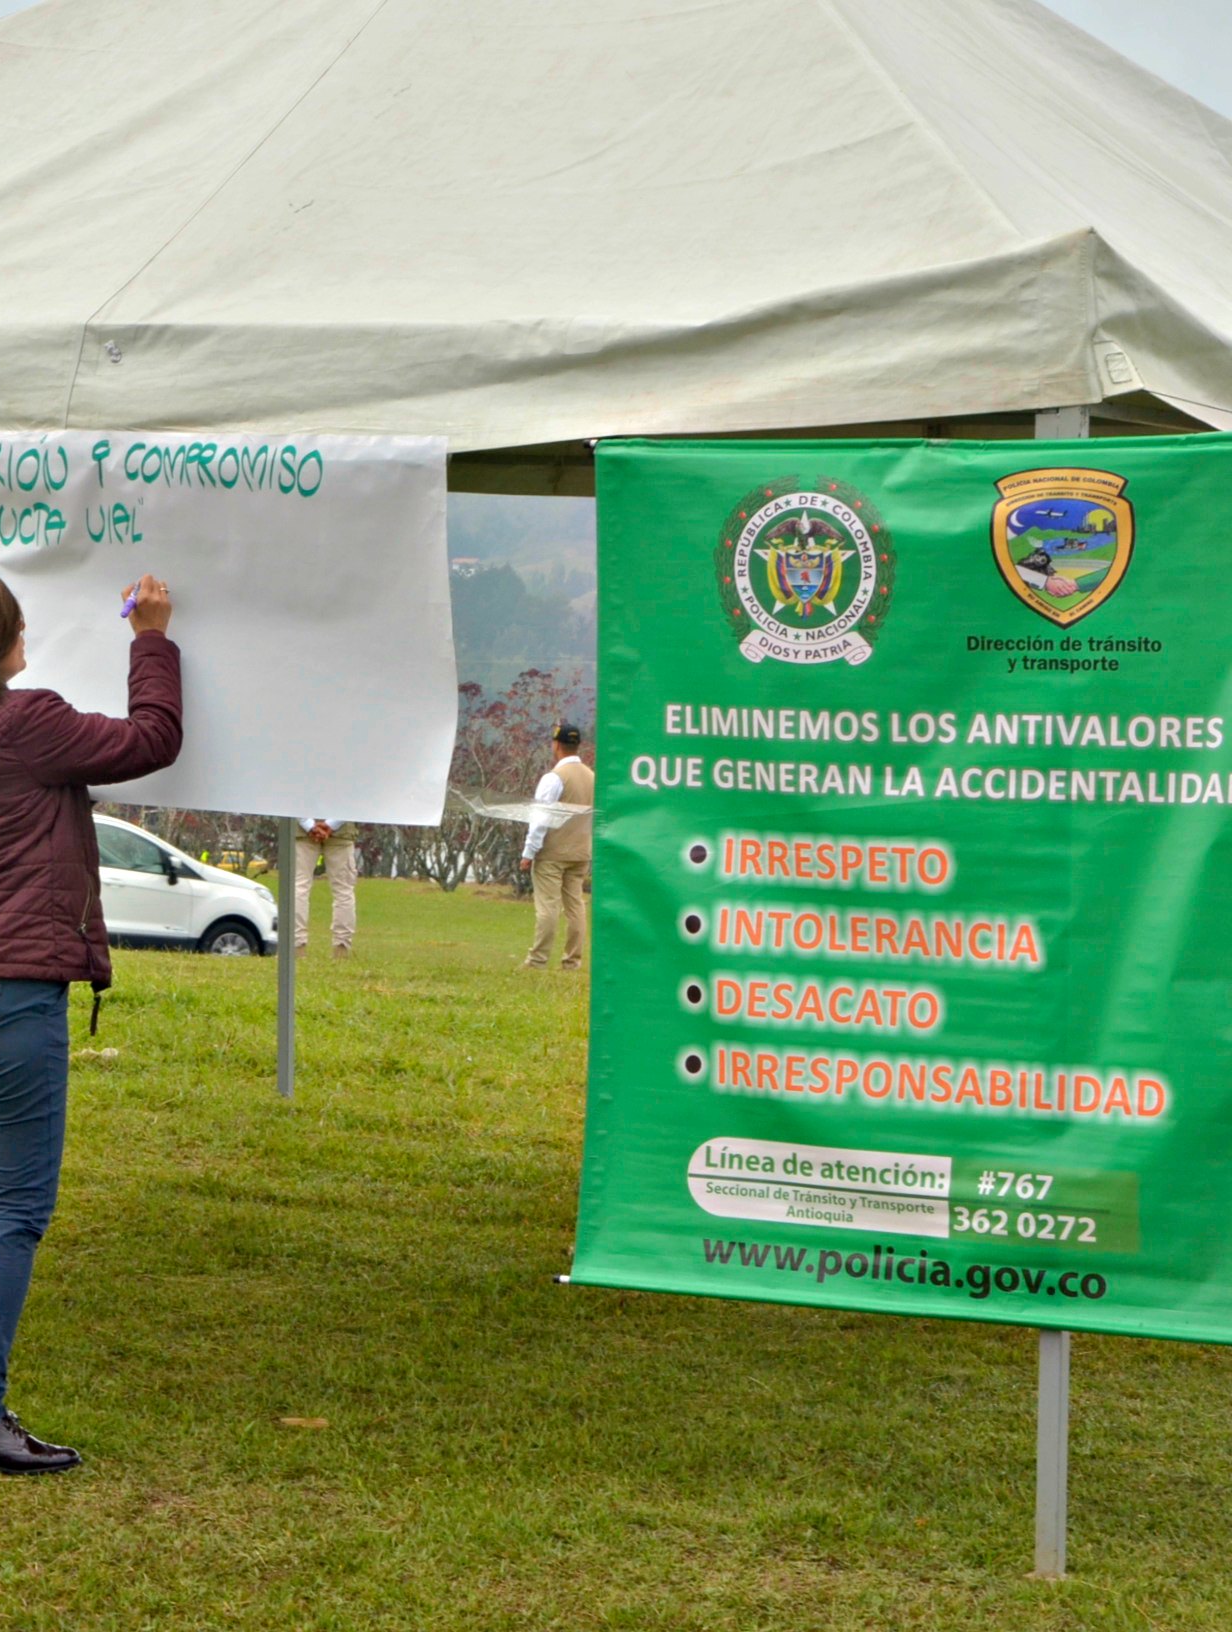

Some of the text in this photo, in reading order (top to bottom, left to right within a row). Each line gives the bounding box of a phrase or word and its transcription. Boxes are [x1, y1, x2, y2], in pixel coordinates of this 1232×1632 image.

[124, 441, 324, 498] COMPROMISO
[798, 495, 819, 506] DE
[832, 504, 874, 581] COLOMBIA
[744, 594, 867, 641] POLICIA NACIONAL
[758, 636, 853, 660] DIOS Y PATRIA
[967, 635, 1162, 652] Dirección de tránsito
[1007, 657, 1120, 673] y transporte
[665, 704, 1224, 749] ELIMINEMOS LOS ANTIVALORES
[630, 755, 1232, 804] QUE GENERAN LA ACCIDENTALIDA
[723, 838, 949, 884] IRRESPETO
[718, 908, 1040, 962] INTOLERANCIA
[716, 979, 939, 1029] DESACATO
[717, 1049, 1167, 1117] IRRESPONSABILIDAD
[704, 1145, 946, 1190] Línea de atención:
[977, 1170, 1054, 1200] #767
[705, 1181, 935, 1215] Seccional de Tránsito y Transporte
[786, 1205, 854, 1223] Antioquia
[953, 1205, 1097, 1243] 362 0272
[702, 1237, 1107, 1299] www.policia.gov.co
